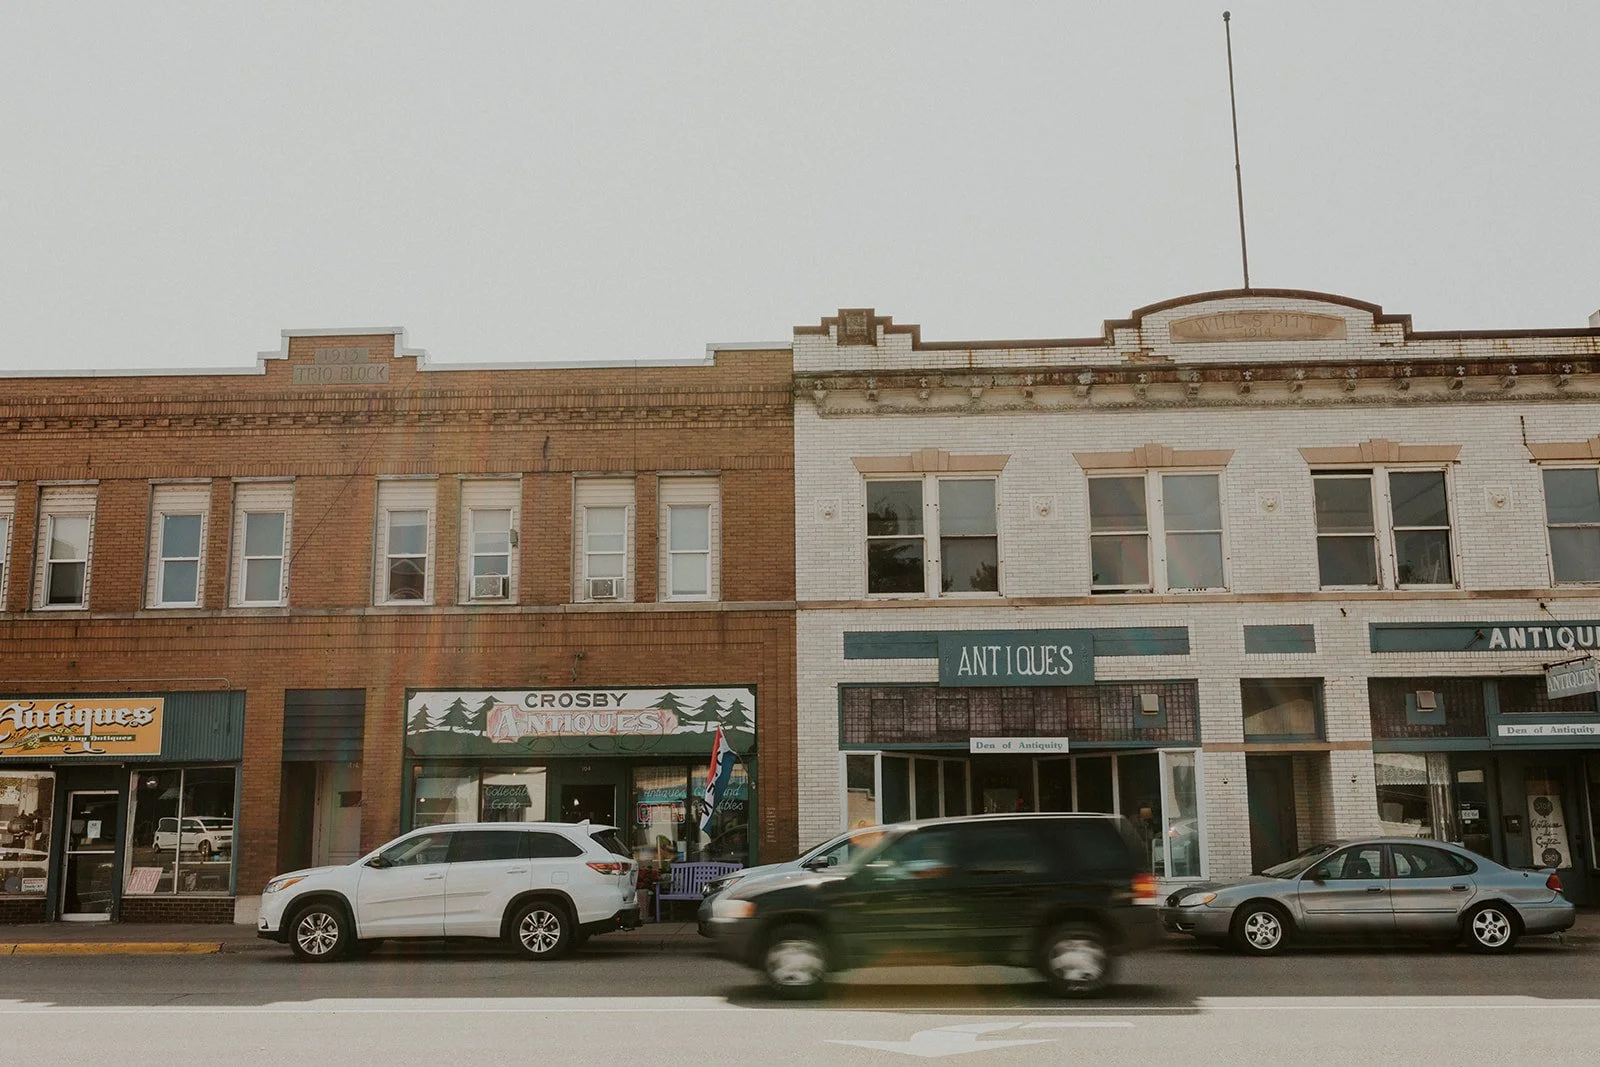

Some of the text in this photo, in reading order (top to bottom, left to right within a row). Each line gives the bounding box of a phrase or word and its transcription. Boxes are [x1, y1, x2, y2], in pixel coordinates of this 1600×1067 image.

[1195, 315, 1243, 333] WILL
[1272, 314, 1317, 330] PITT
[296, 365, 386, 382] TRIO BLOCK
[957, 644, 1074, 676] ANTIQUES
[1547, 667, 1596, 692] ANTIQUES
[524, 692, 628, 708] CROSBY
[0, 701, 157, 754] Antiques
[492, 706, 660, 737] ANTIQUES
[1507, 725, 1595, 735] Den of Antiquity
[976, 741, 1063, 750] Den of Antiquity
